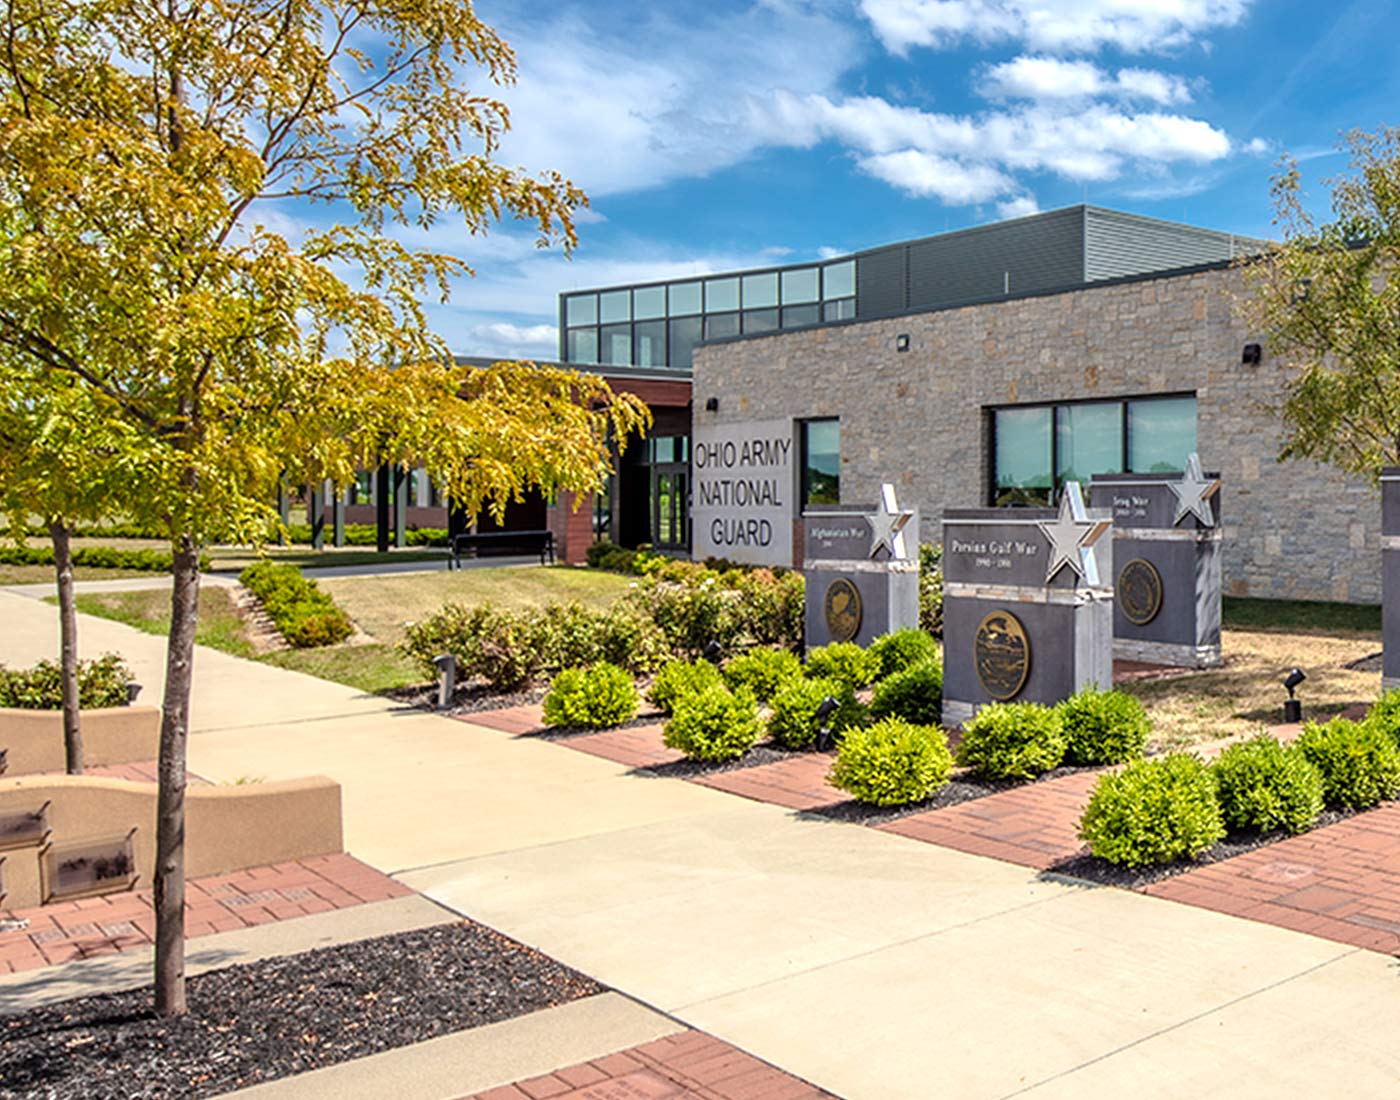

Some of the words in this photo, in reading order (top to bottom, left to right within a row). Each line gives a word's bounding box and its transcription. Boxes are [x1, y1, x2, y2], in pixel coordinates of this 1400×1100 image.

[695, 441, 736, 469] OHIO
[740, 438, 791, 467] ARMY
[700, 479, 782, 506] NATIONAL
[1132, 495, 1149, 506] War
[711, 518, 772, 547] GUARD
[850, 527, 865, 539] War
[952, 540, 987, 553] Persian
[989, 541, 1012, 554] Gulf
[1015, 542, 1037, 555] War
